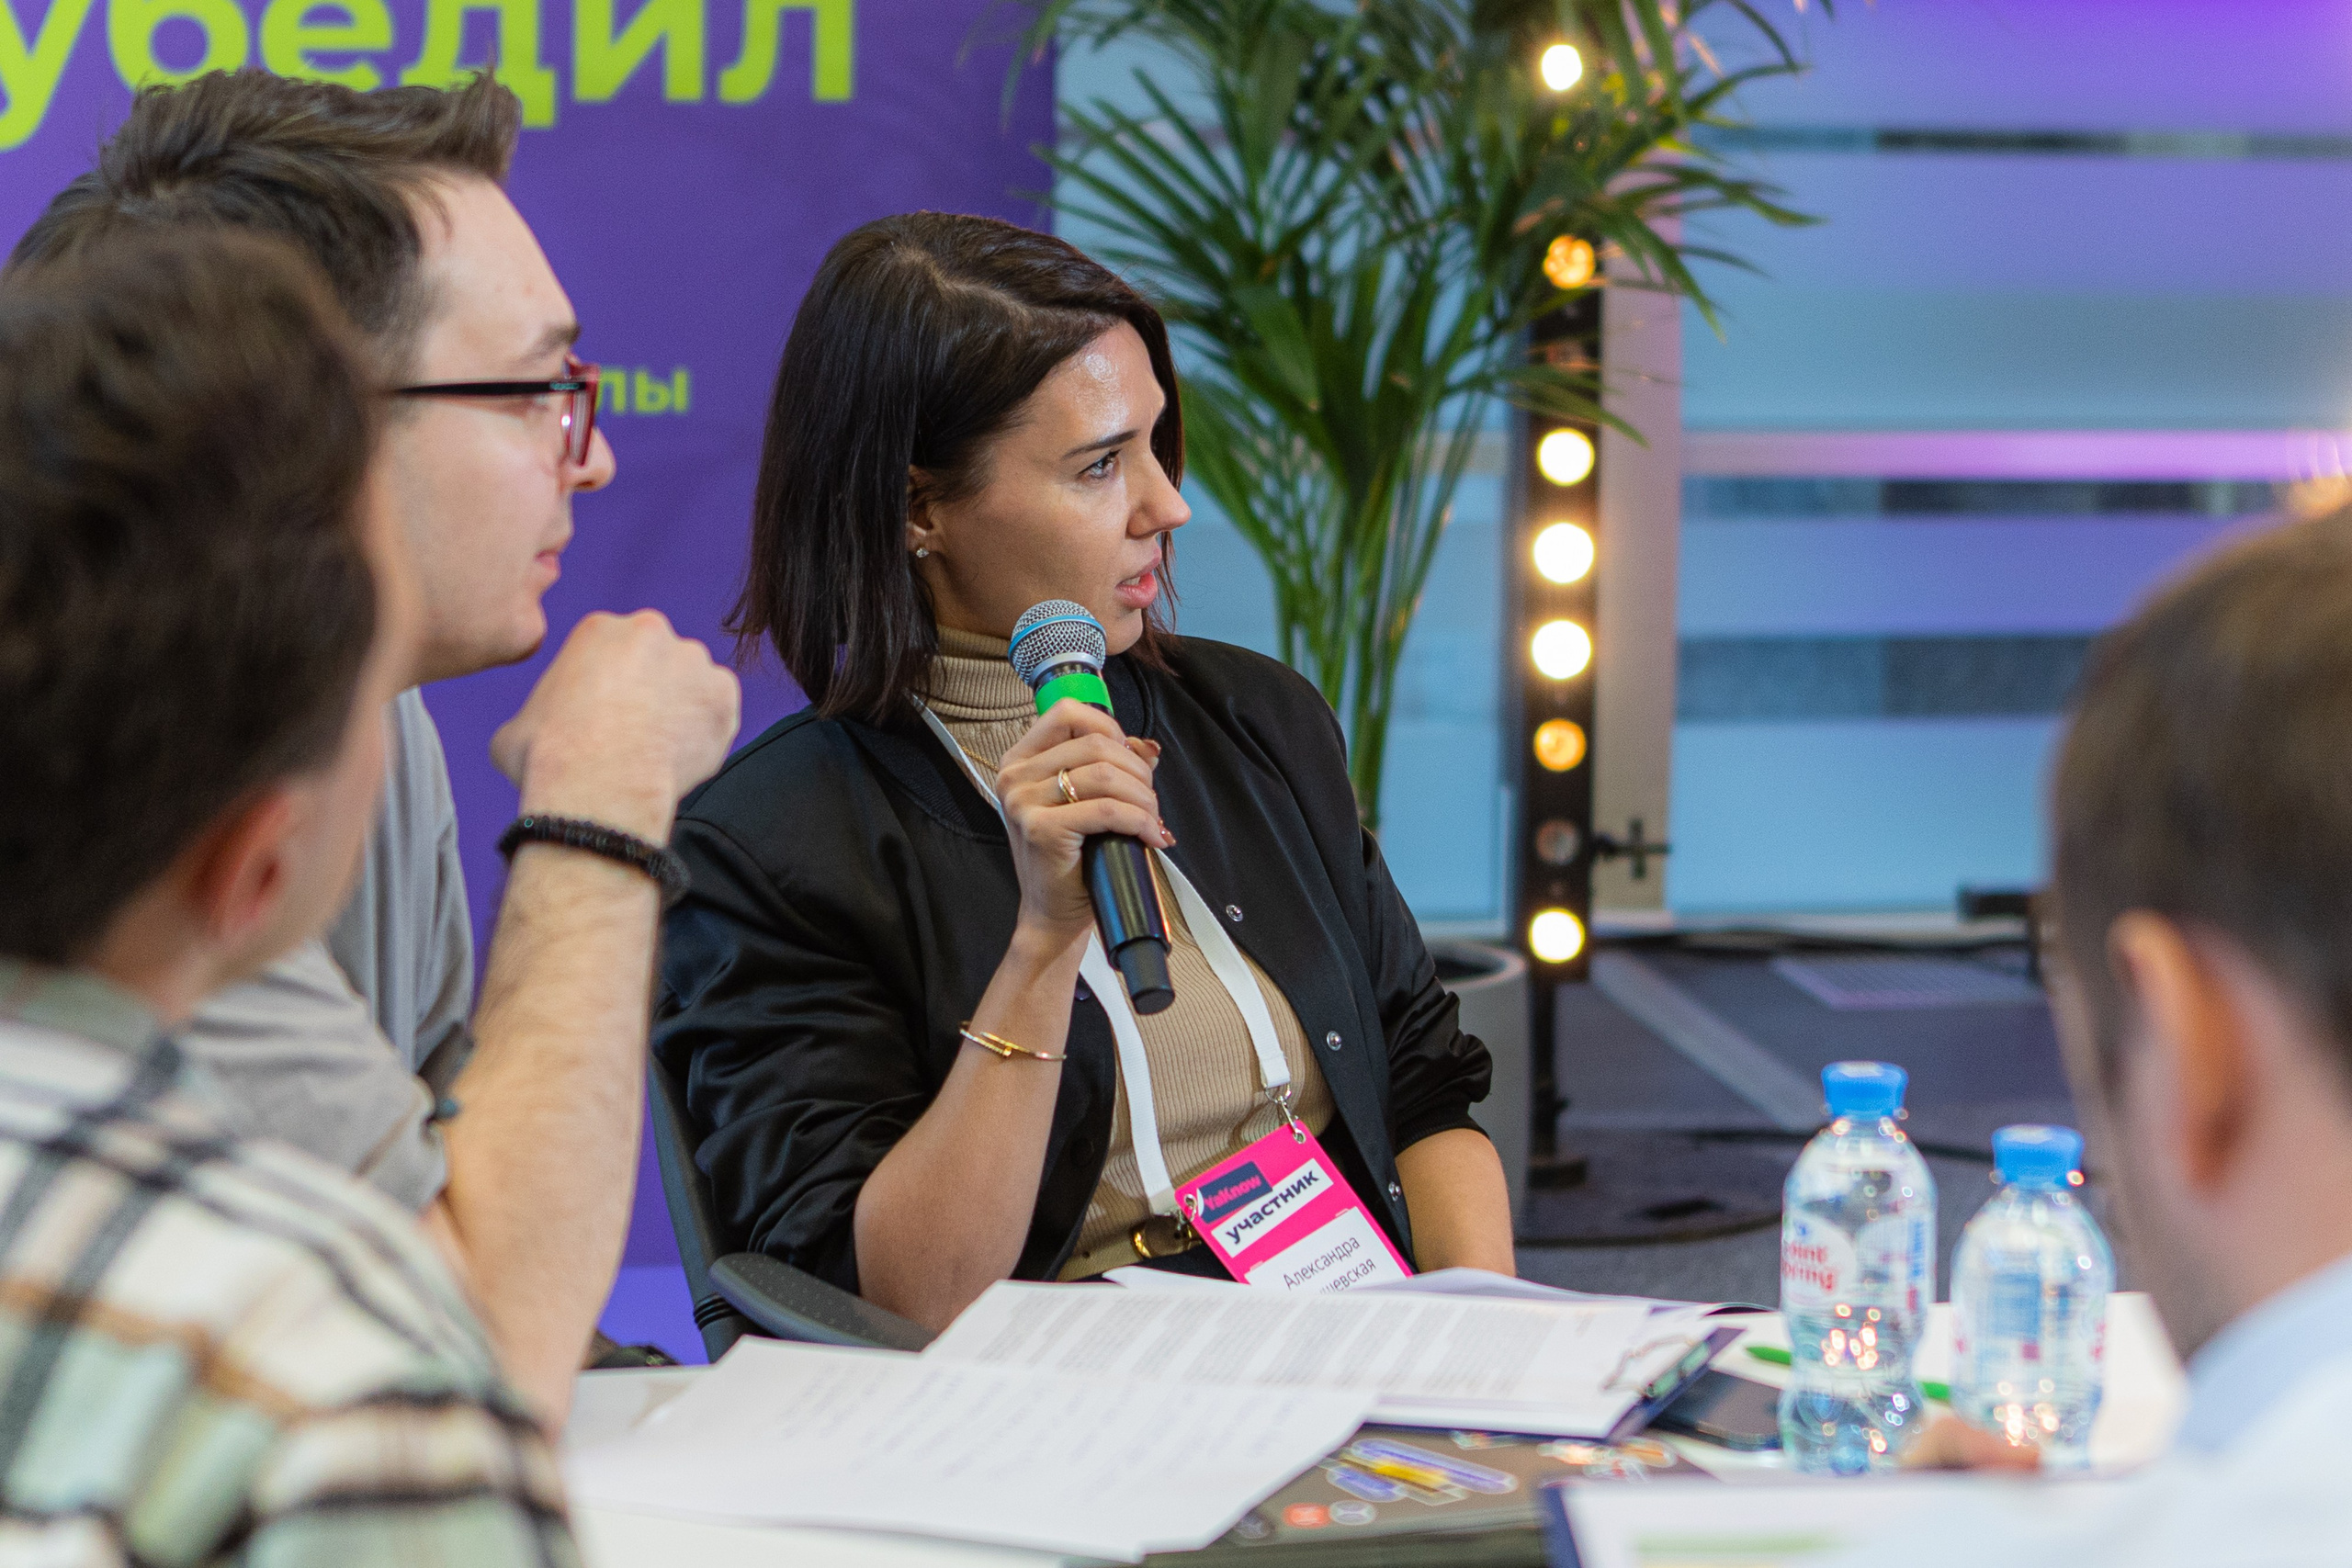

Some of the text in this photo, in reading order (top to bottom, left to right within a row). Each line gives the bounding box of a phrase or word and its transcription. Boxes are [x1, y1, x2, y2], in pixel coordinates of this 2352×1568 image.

[0, 0, 855, 151] убедил
[1226, 1170, 1319, 1245] участник
[1283, 1236, 1361, 1291] Александра
